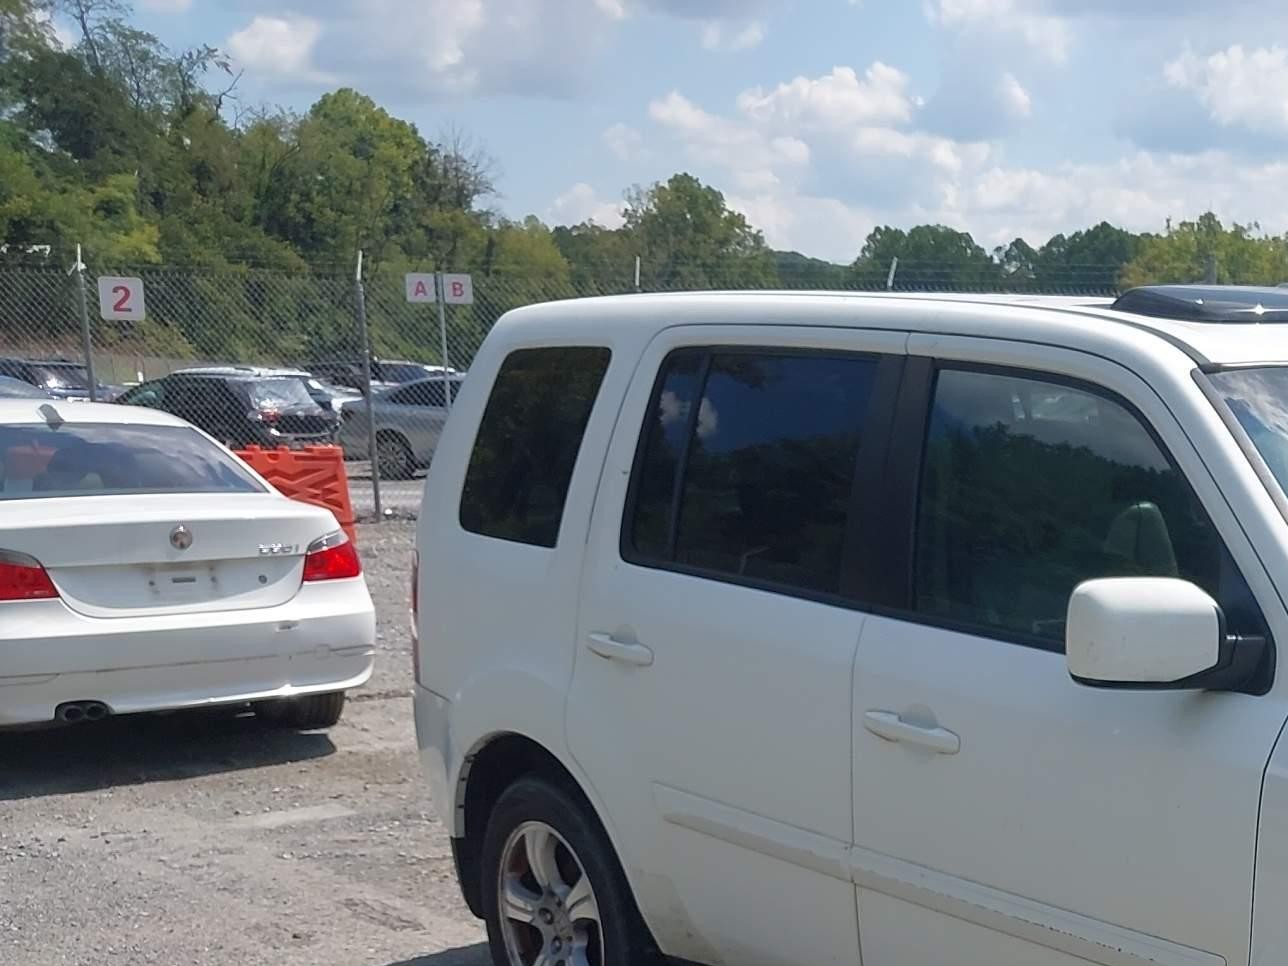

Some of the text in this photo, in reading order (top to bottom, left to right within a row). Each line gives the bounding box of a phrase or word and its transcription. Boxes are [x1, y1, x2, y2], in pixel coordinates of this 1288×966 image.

[414, 280, 428, 296] A
[452, 281, 465, 297] B
[112, 285, 132, 312] 2
